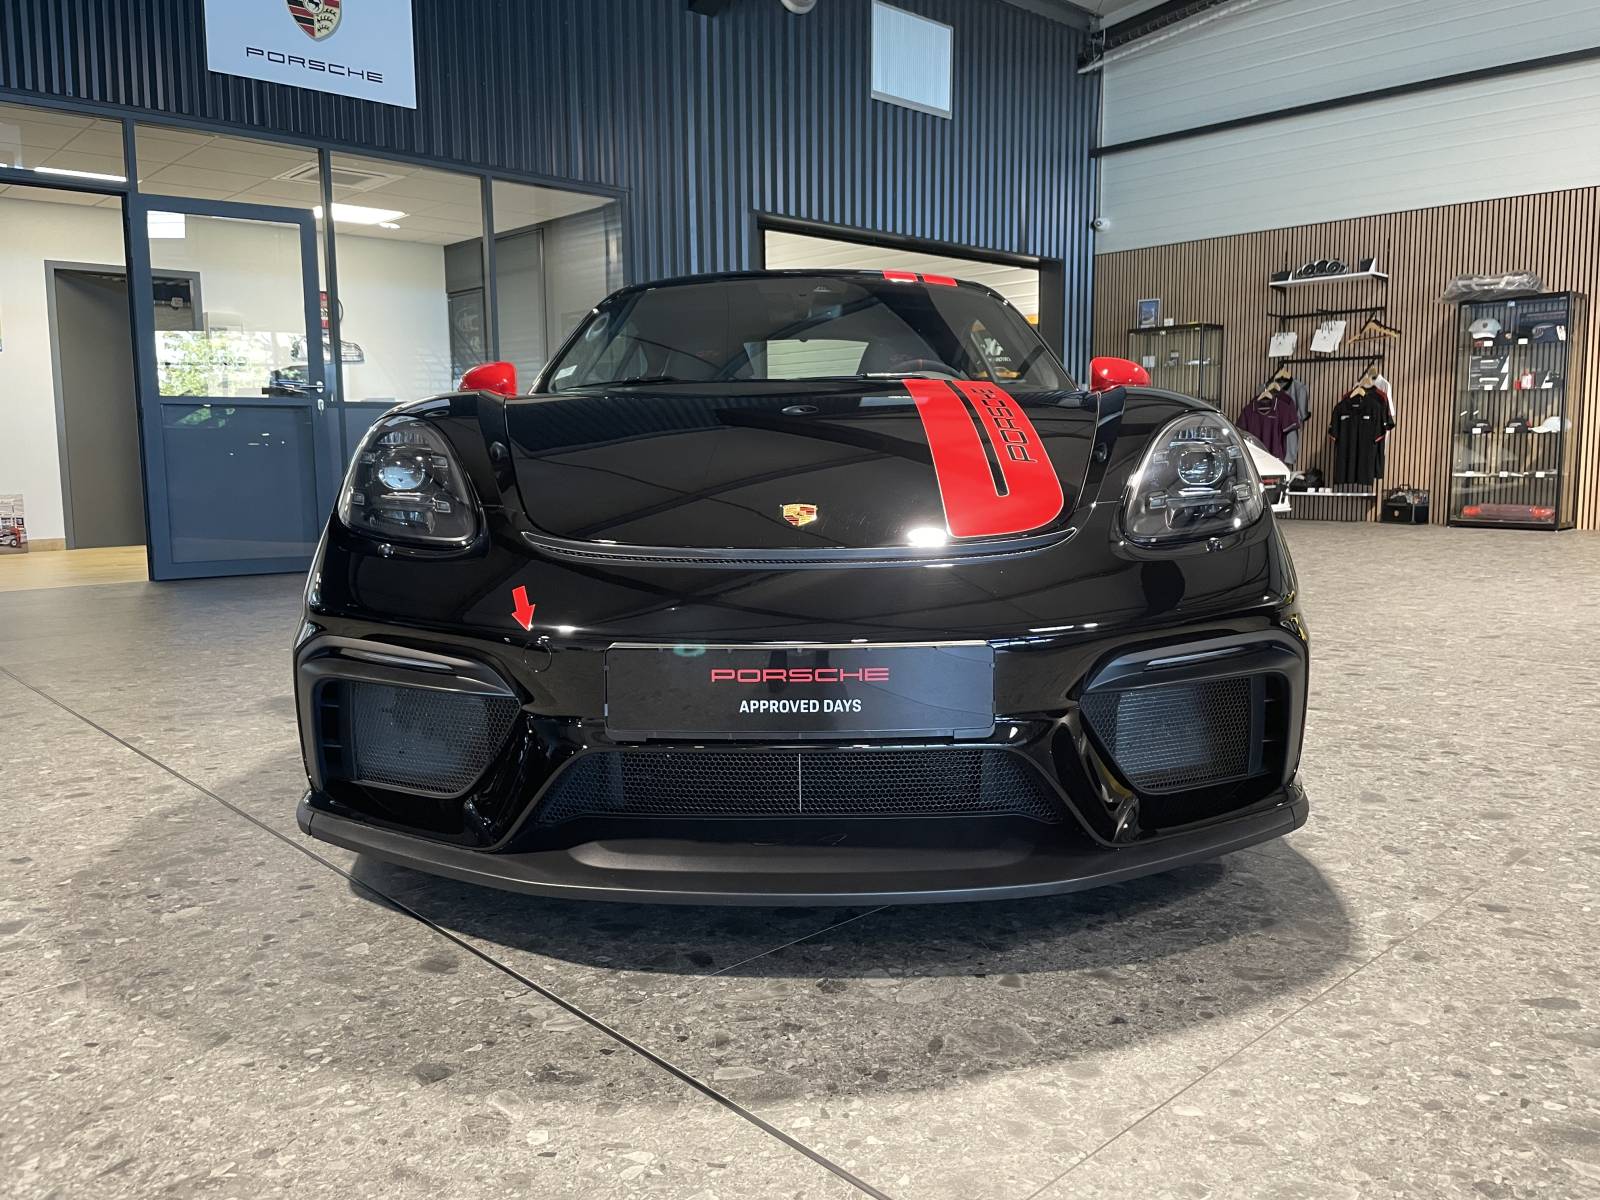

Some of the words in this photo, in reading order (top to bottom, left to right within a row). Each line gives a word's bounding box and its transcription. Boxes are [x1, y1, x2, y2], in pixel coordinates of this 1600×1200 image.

[246, 46, 383, 83] PORSCHE
[970, 387, 1038, 463] PORSCHE
[711, 667, 890, 683] PORSCHE
[739, 699, 819, 713] APPROVED
[823, 699, 862, 713] DAYS
